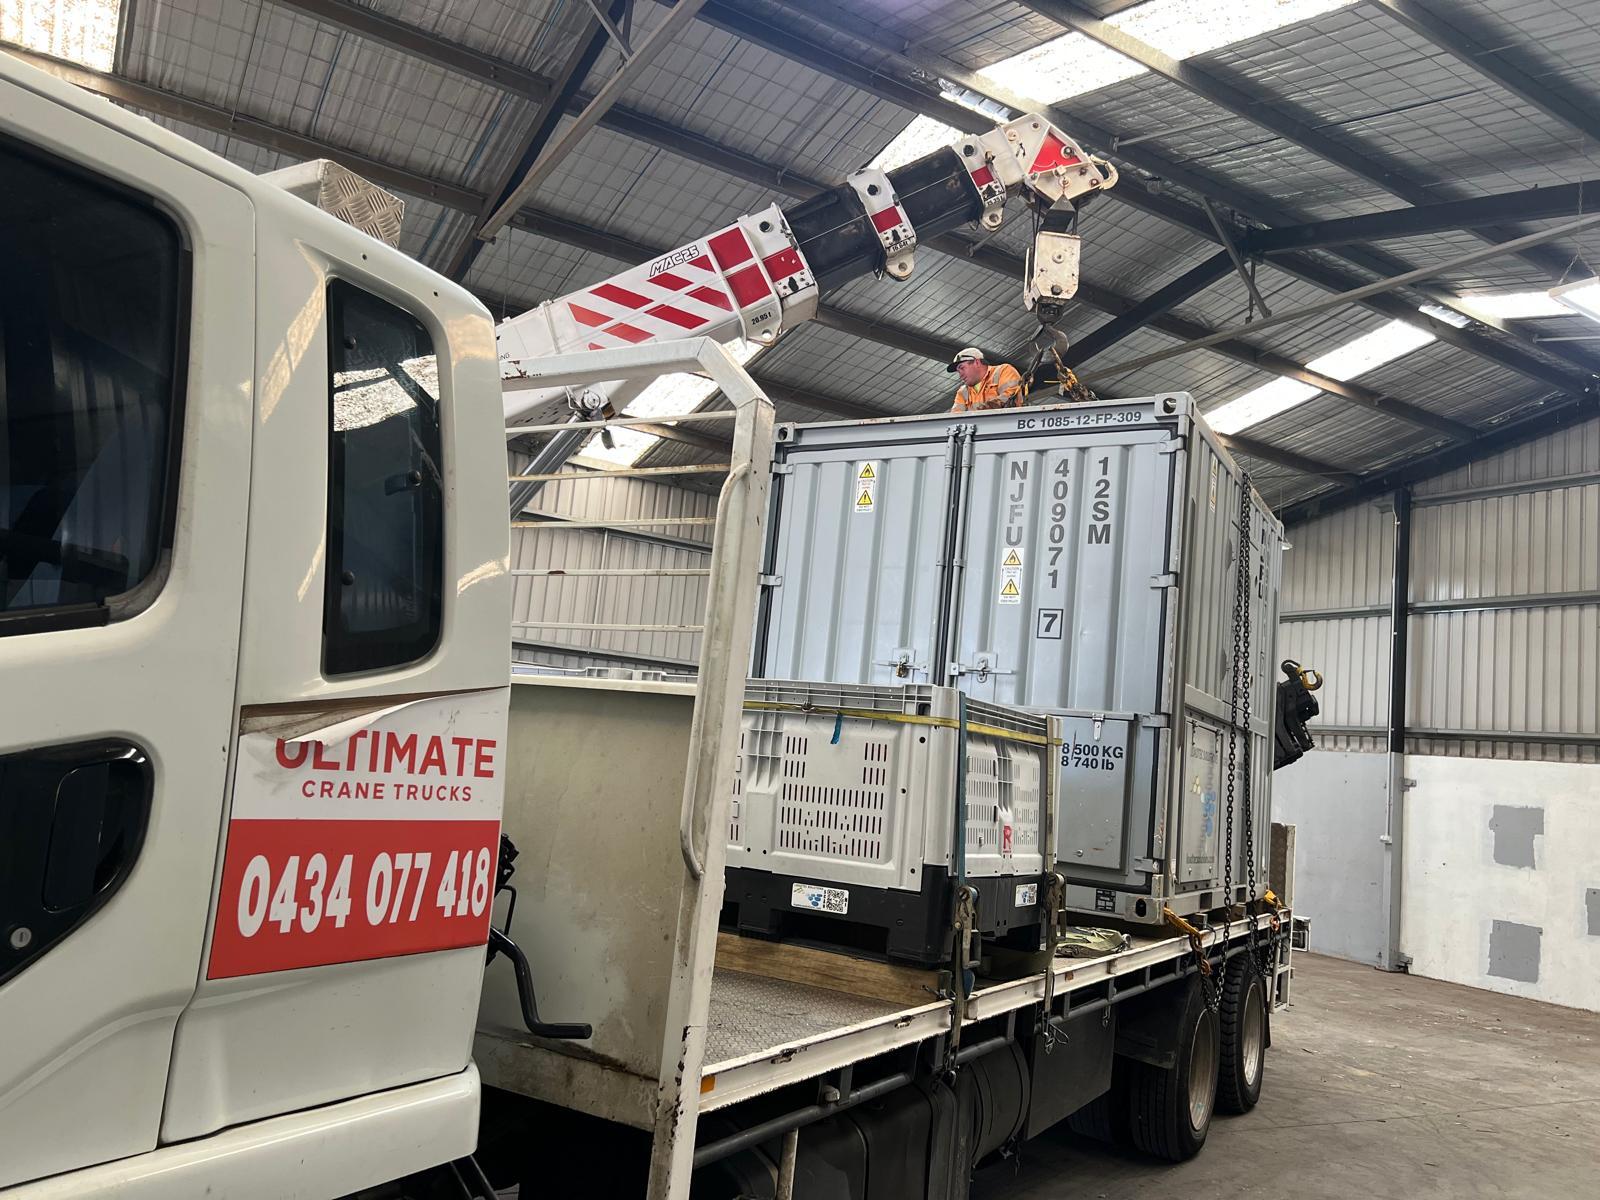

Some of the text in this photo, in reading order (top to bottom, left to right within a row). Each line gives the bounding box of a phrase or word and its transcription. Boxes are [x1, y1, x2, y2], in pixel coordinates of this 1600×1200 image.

[1017, 411, 1142, 429] BC 1085-12-FP-309
[1005, 460, 1028, 546] NJFU
[1087, 456, 1111, 544] 12SM
[1048, 458, 1070, 589] 409071
[1042, 613, 1058, 633] 7
[275, 729, 497, 778] ULTIMATE
[1073, 756, 1099, 769] 740
[1101, 758, 1115, 771] lb
[1074, 743, 1100, 757] 500
[1102, 745, 1124, 759] KG
[302, 780, 472, 802] CRANE TRUCKS
[237, 847, 491, 938] 0434 077 418
